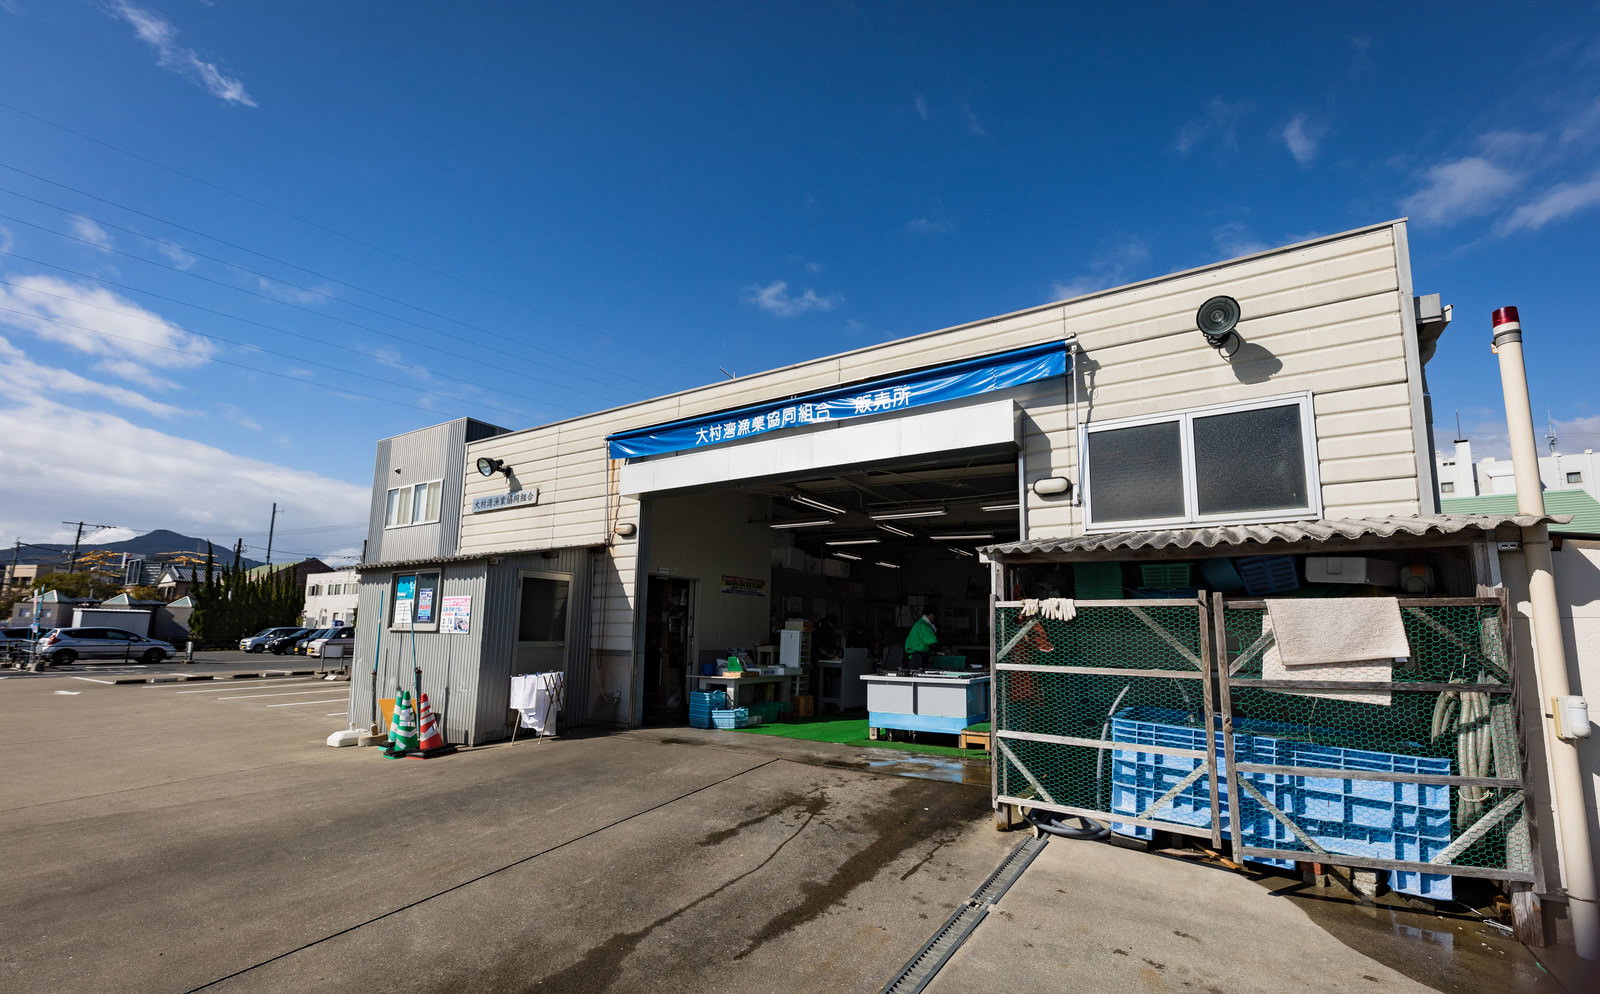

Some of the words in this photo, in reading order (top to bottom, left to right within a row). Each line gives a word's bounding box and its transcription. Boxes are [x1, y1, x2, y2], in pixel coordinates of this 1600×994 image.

[695, 402, 831, 445] 大村湾漁業協同組合
[854, 384, 912, 414] 販売所
